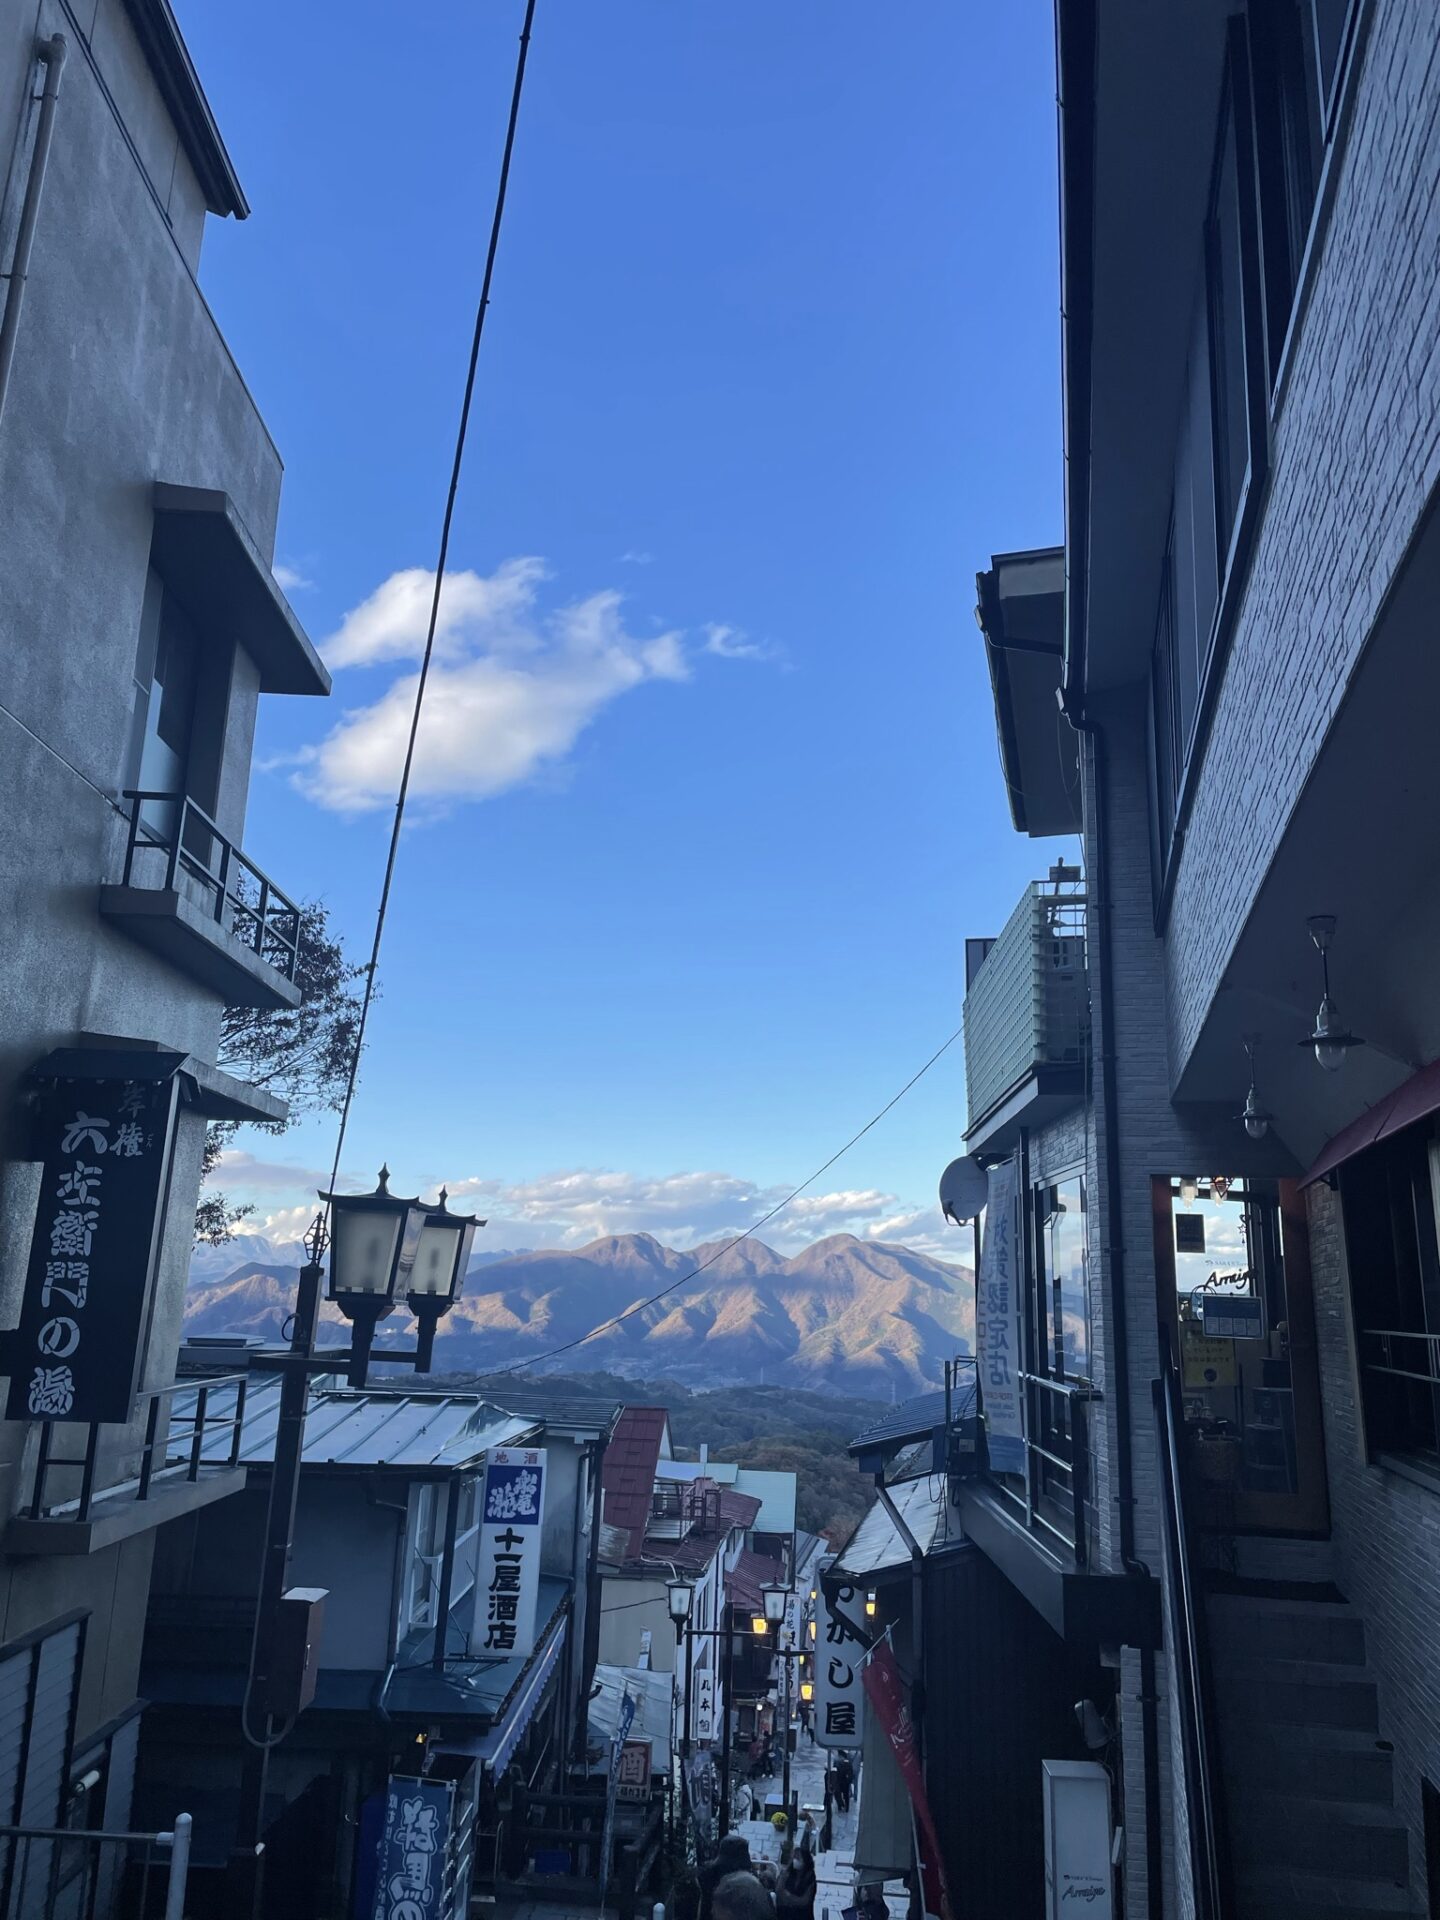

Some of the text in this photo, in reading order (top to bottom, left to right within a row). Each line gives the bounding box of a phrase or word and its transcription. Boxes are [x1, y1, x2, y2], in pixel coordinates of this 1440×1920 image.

[483, 1527, 525, 1651] 十一屋酒店
